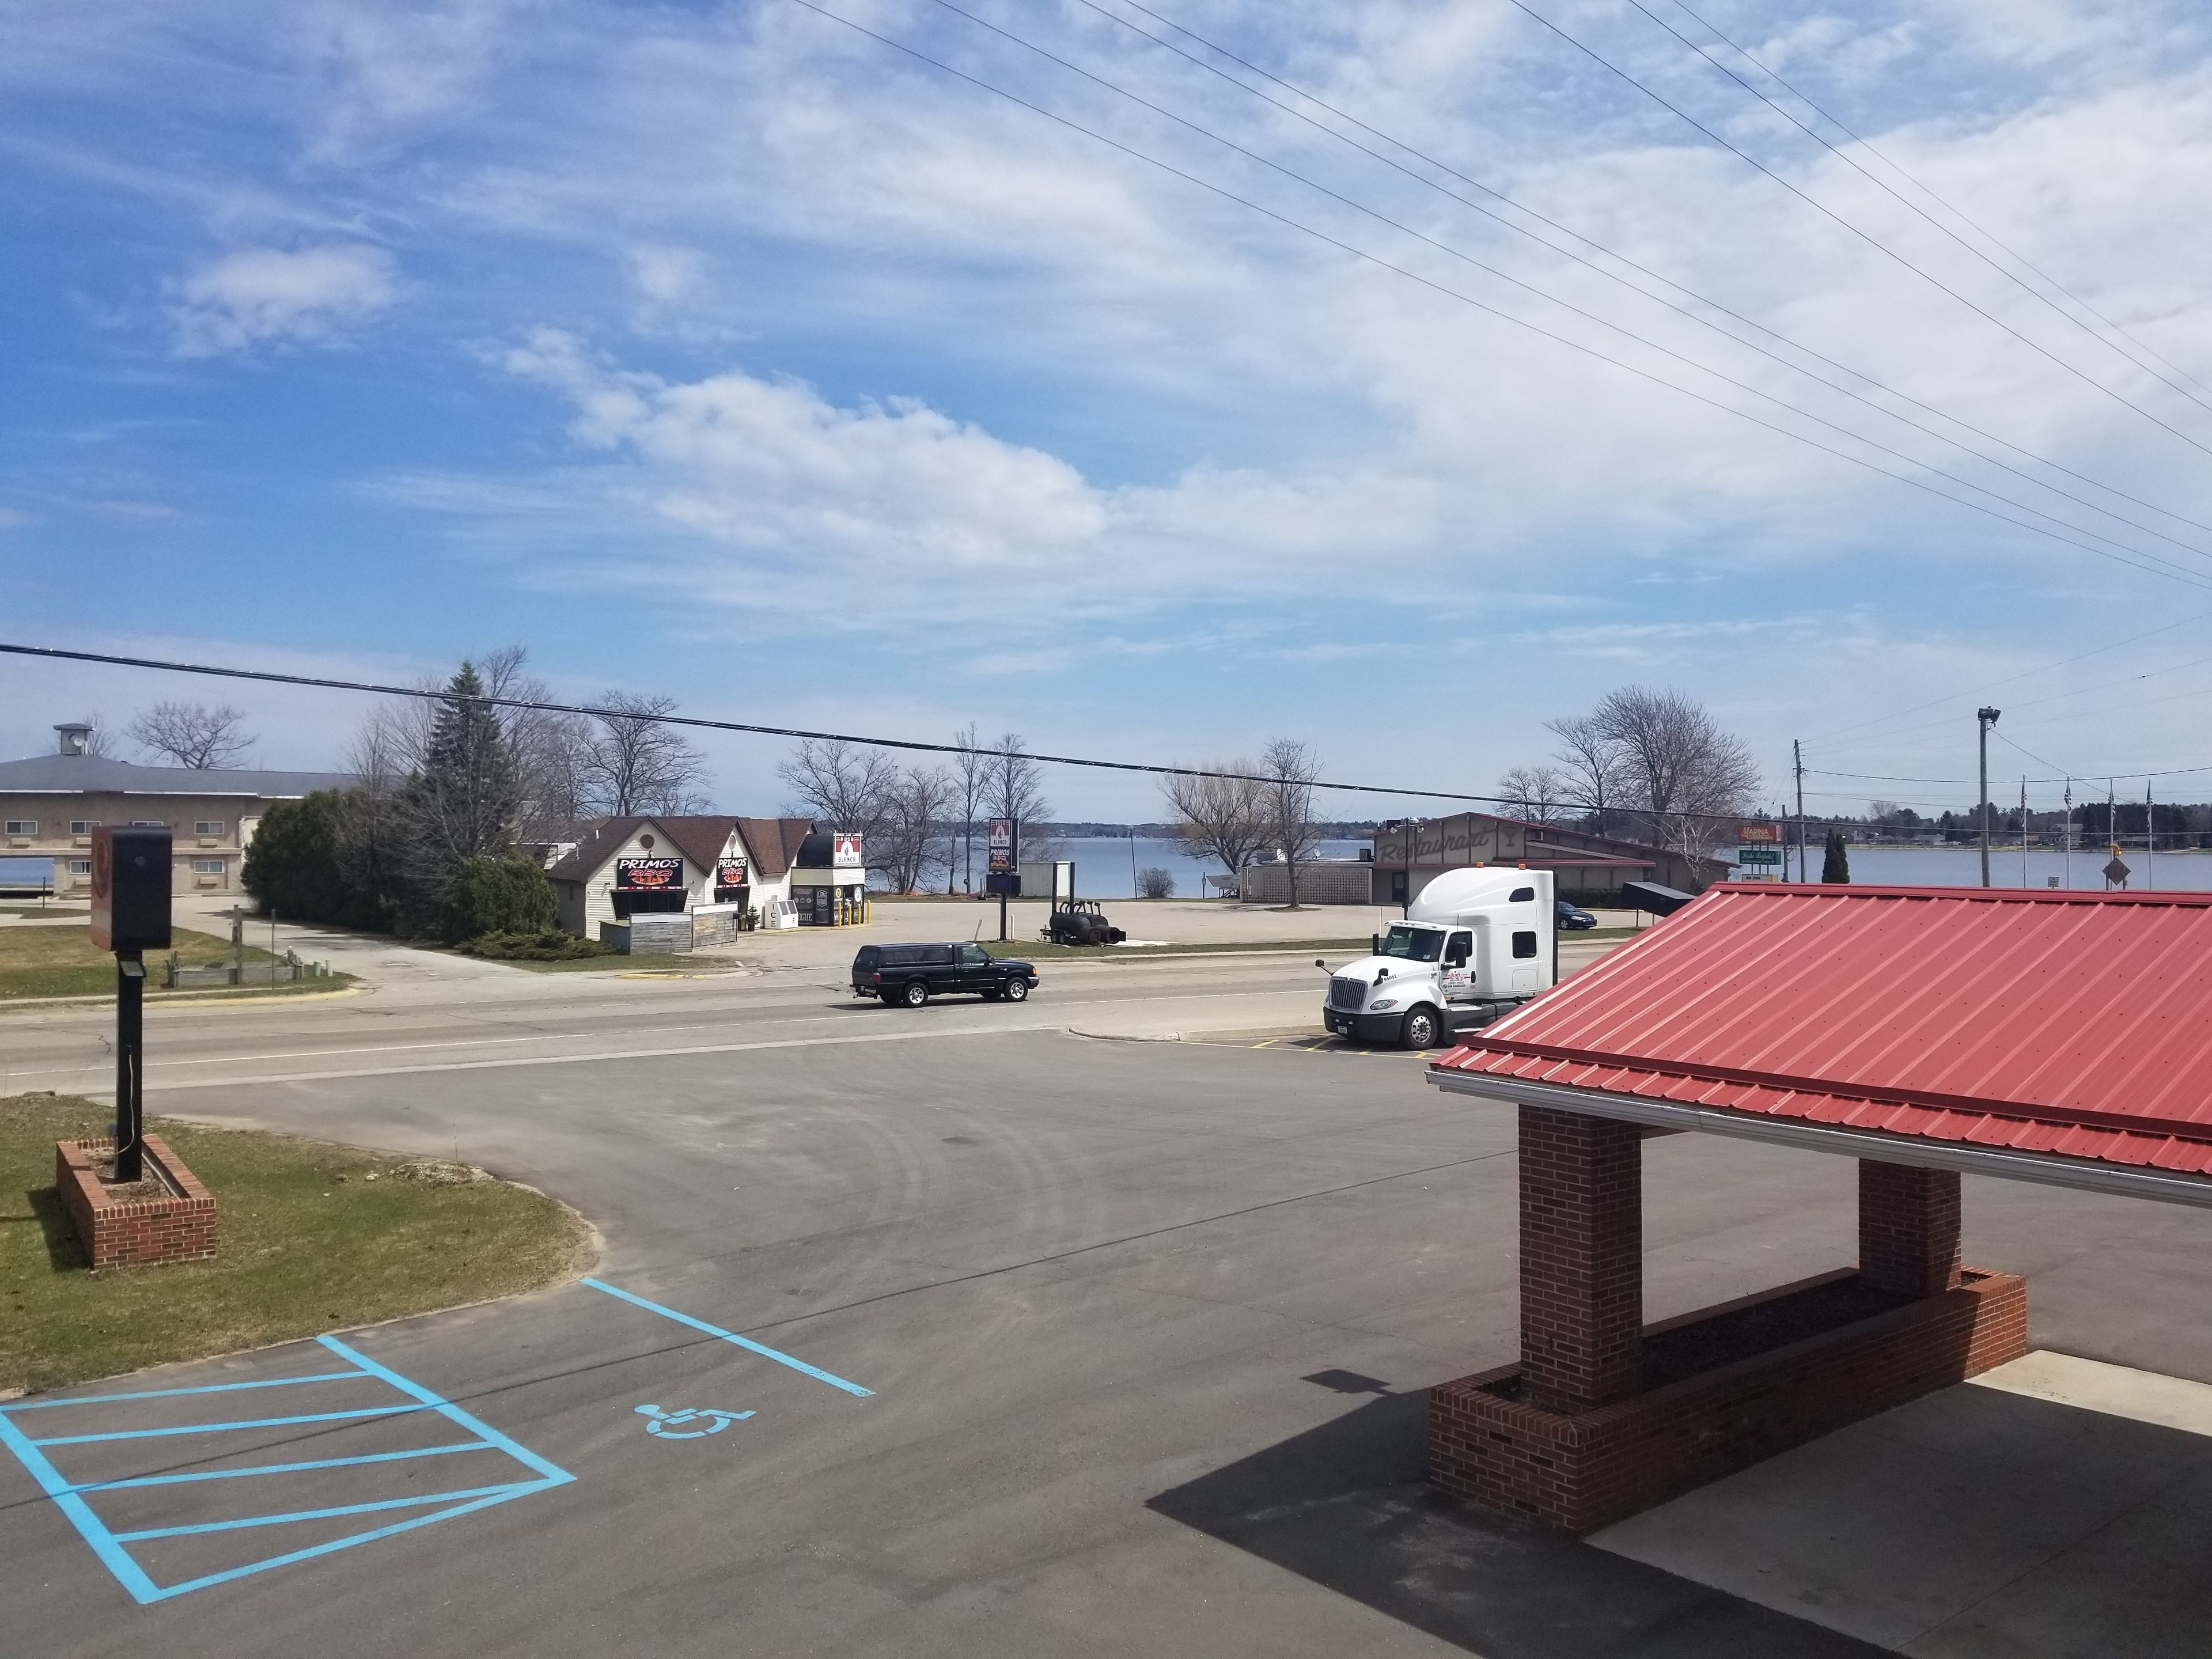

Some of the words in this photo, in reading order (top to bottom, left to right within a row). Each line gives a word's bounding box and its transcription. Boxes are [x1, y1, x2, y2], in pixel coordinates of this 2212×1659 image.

[1741, 827, 1769, 839] MARINA
[1379, 826, 1497, 862] Restaurant
[619, 858, 681, 869] PRIMOS
[718, 858, 747, 869] PRIMOS
[627, 869, 673, 877] BBQ
